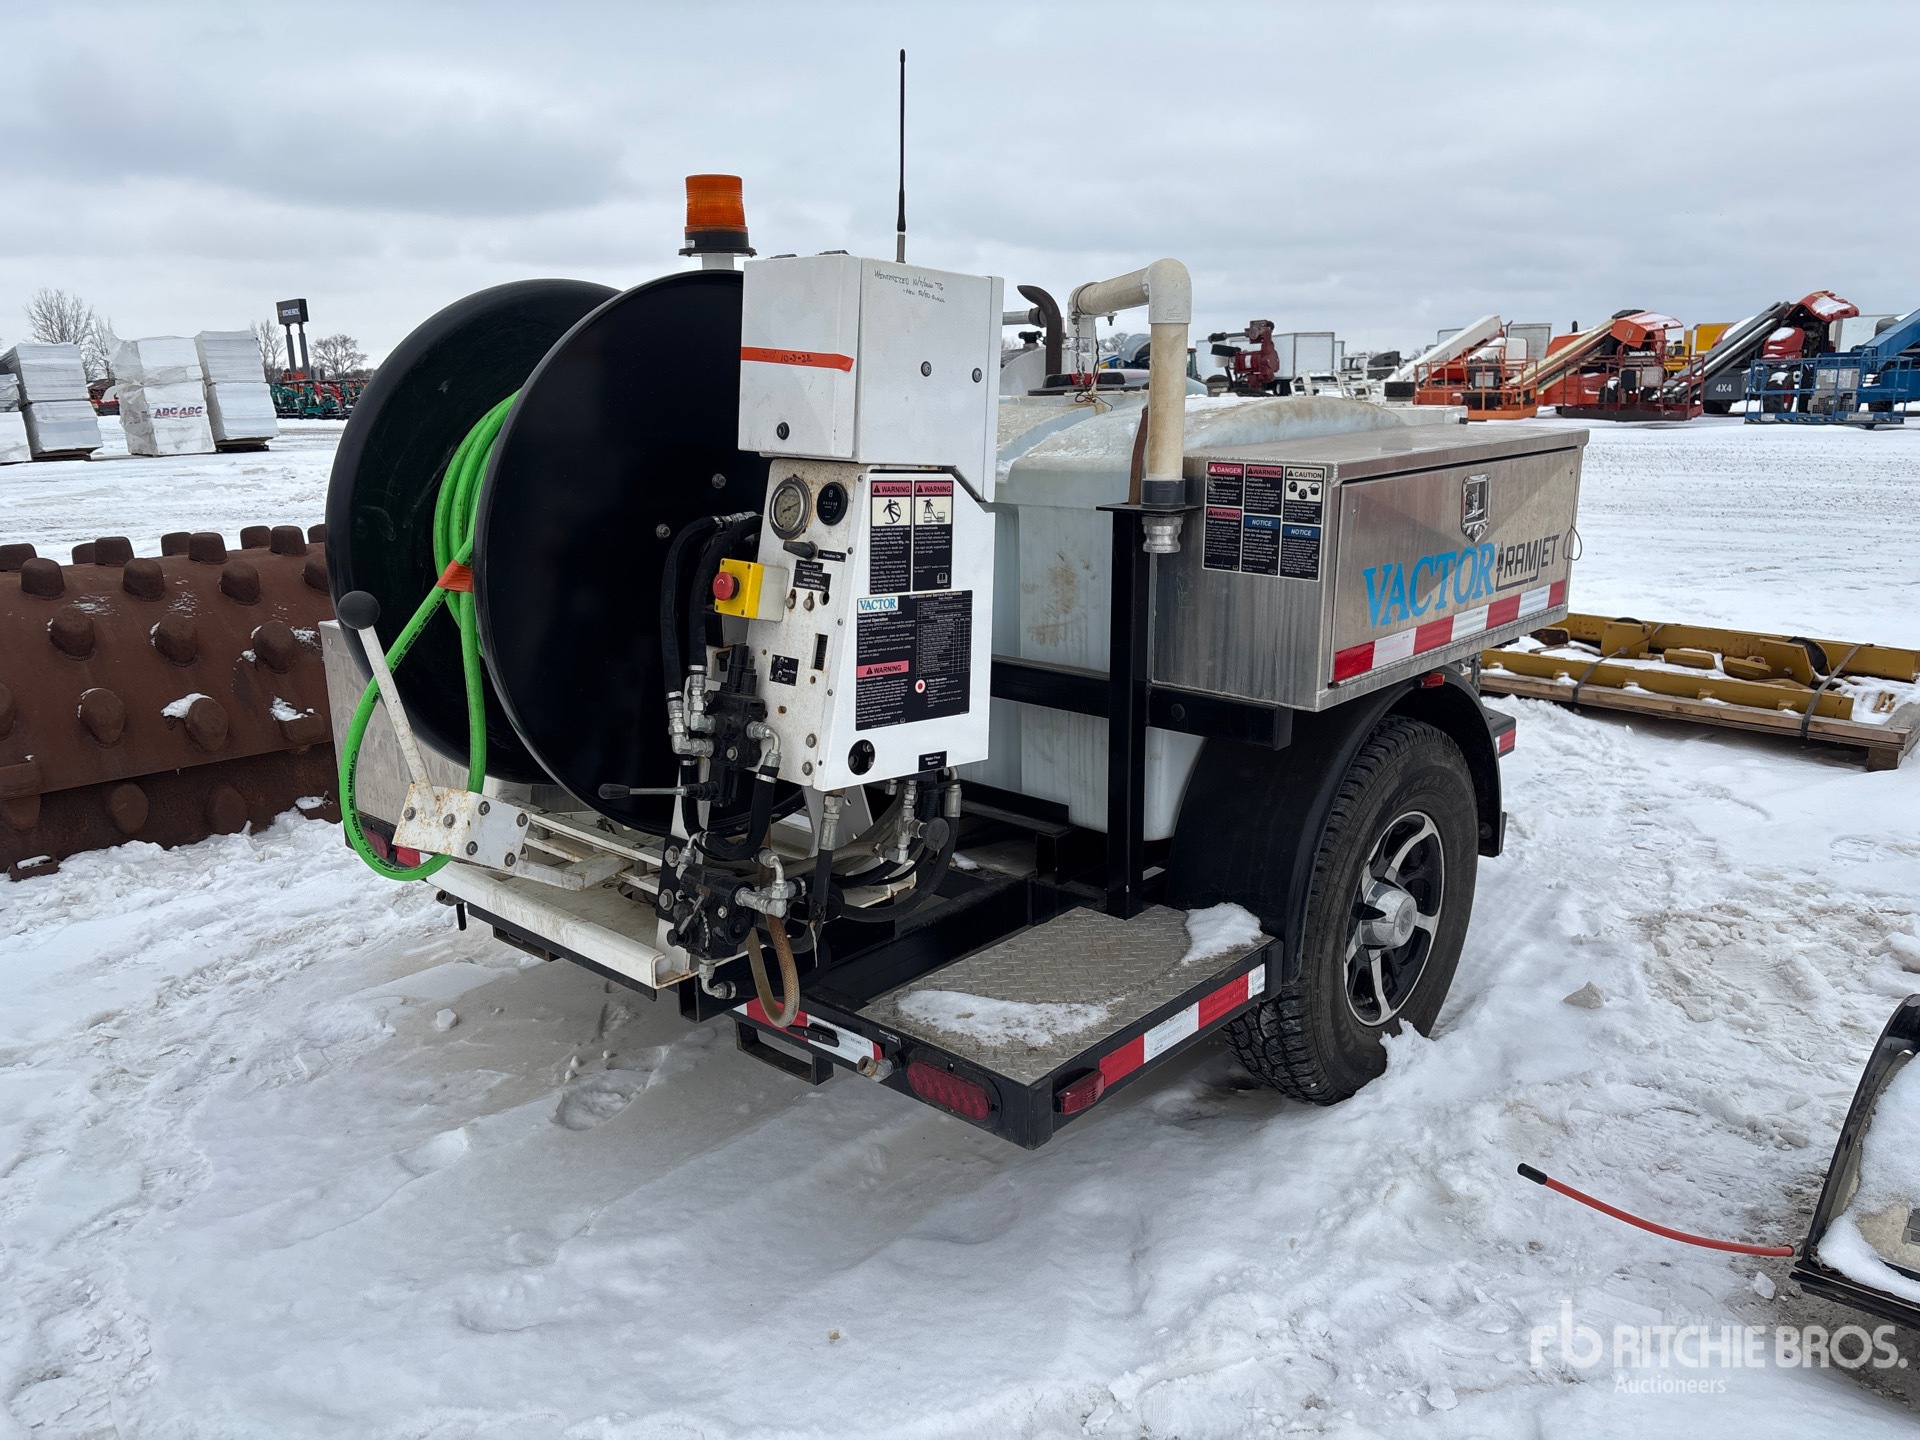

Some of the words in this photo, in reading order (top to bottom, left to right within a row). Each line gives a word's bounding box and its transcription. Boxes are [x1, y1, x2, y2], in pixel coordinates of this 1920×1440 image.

[1715, 382, 1733, 393] 4X4
[155, 407, 178, 417] ABC
[180, 406, 203, 416] ABC
[1216, 466, 1242, 474] DANGER
[1253, 469, 1281, 477] WARNING
[1294, 471, 1322, 479] CAUTION
[1213, 511, 1240, 519] WARNING
[1251, 519, 1273, 527] NOTICE
[1290, 528, 1313, 536] NOTICE
[1362, 543, 1495, 629] VACTOR
[1503, 535, 1560, 581] RAMJET
[859, 598, 897, 611] VACTOR
[873, 664, 902, 674] WARNING
